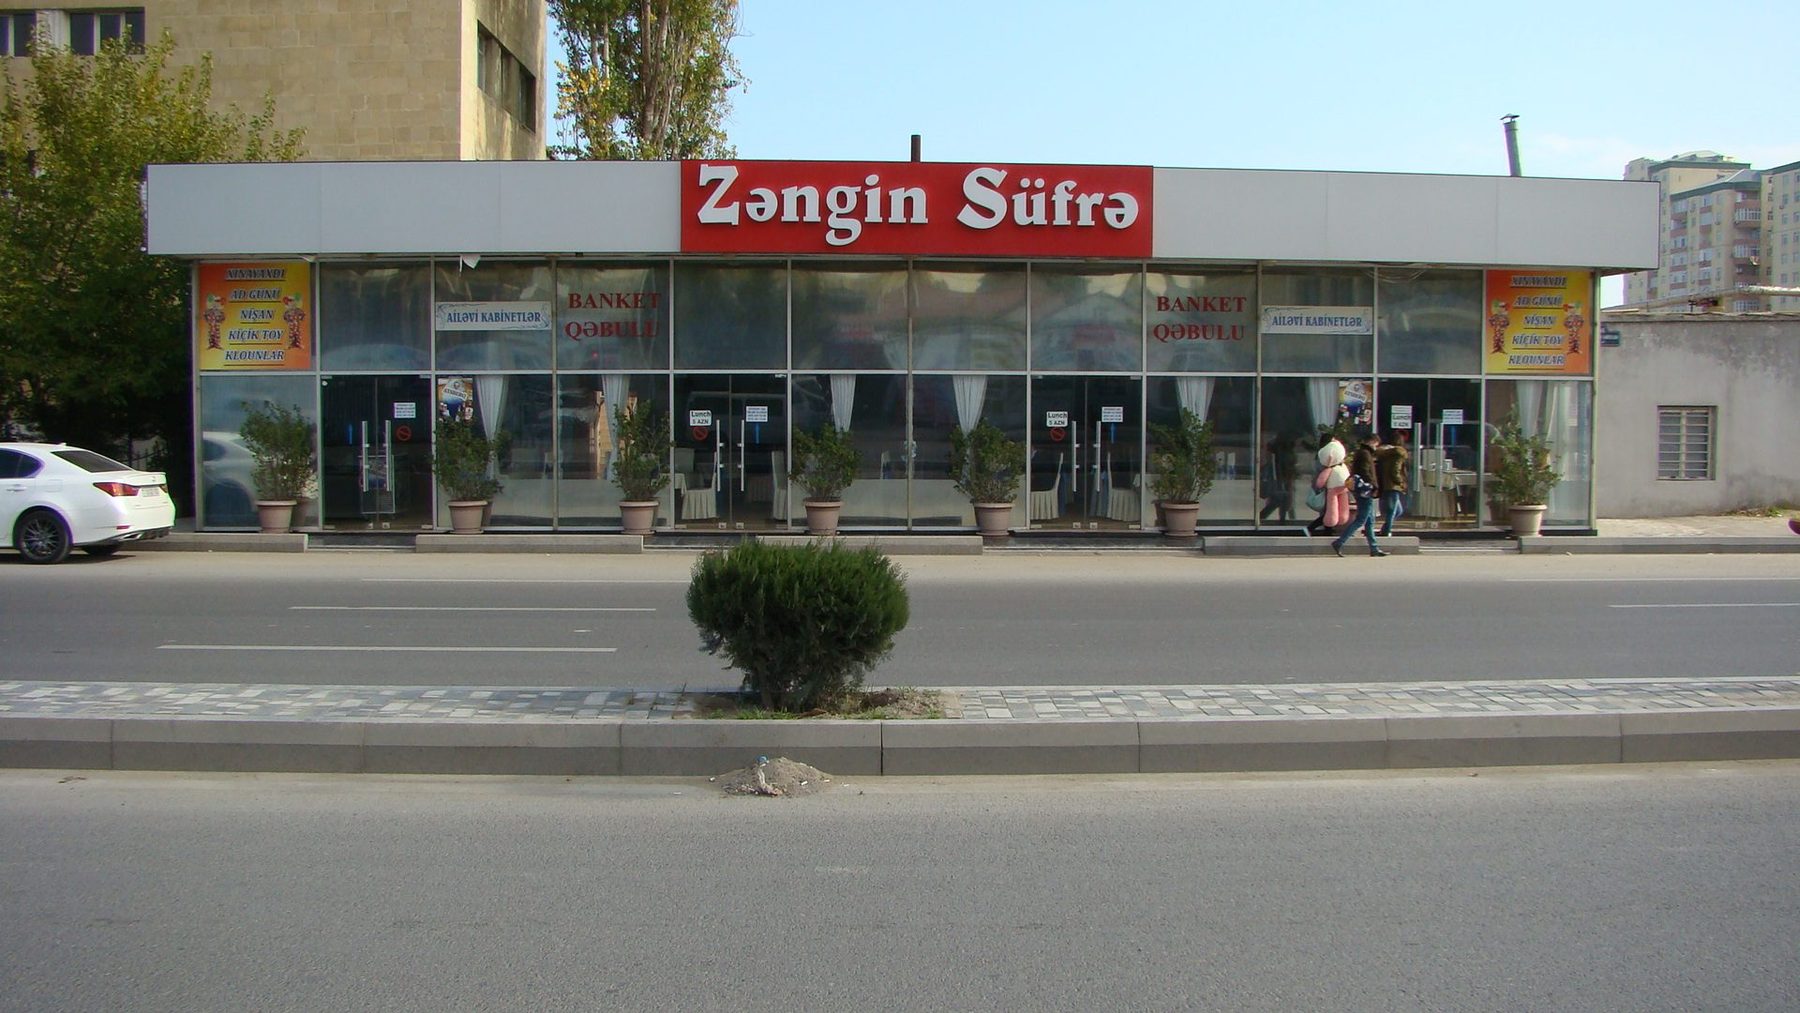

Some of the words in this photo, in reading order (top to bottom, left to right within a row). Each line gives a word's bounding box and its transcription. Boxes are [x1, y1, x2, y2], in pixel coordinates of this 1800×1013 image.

[697, 163, 930, 247] Zəngin
[955, 166, 1140, 231] Süfrə
[231, 289, 247, 300] AD
[568, 293, 662, 309] BANKET
[1156, 296, 1247, 313] BANKET
[446, 309, 479, 323] AİLƏVİ
[481, 309, 542, 323] KABİNETLƏR
[1271, 314, 1304, 327] AİLƏVİ
[1305, 313, 1363, 327] KABİNETLƏR
[262, 330, 284, 340] TOY
[565, 321, 660, 341] QƏBULU
[1153, 323, 1246, 343] QƏBULU
[225, 350, 286, 361] KLOUNLAR
